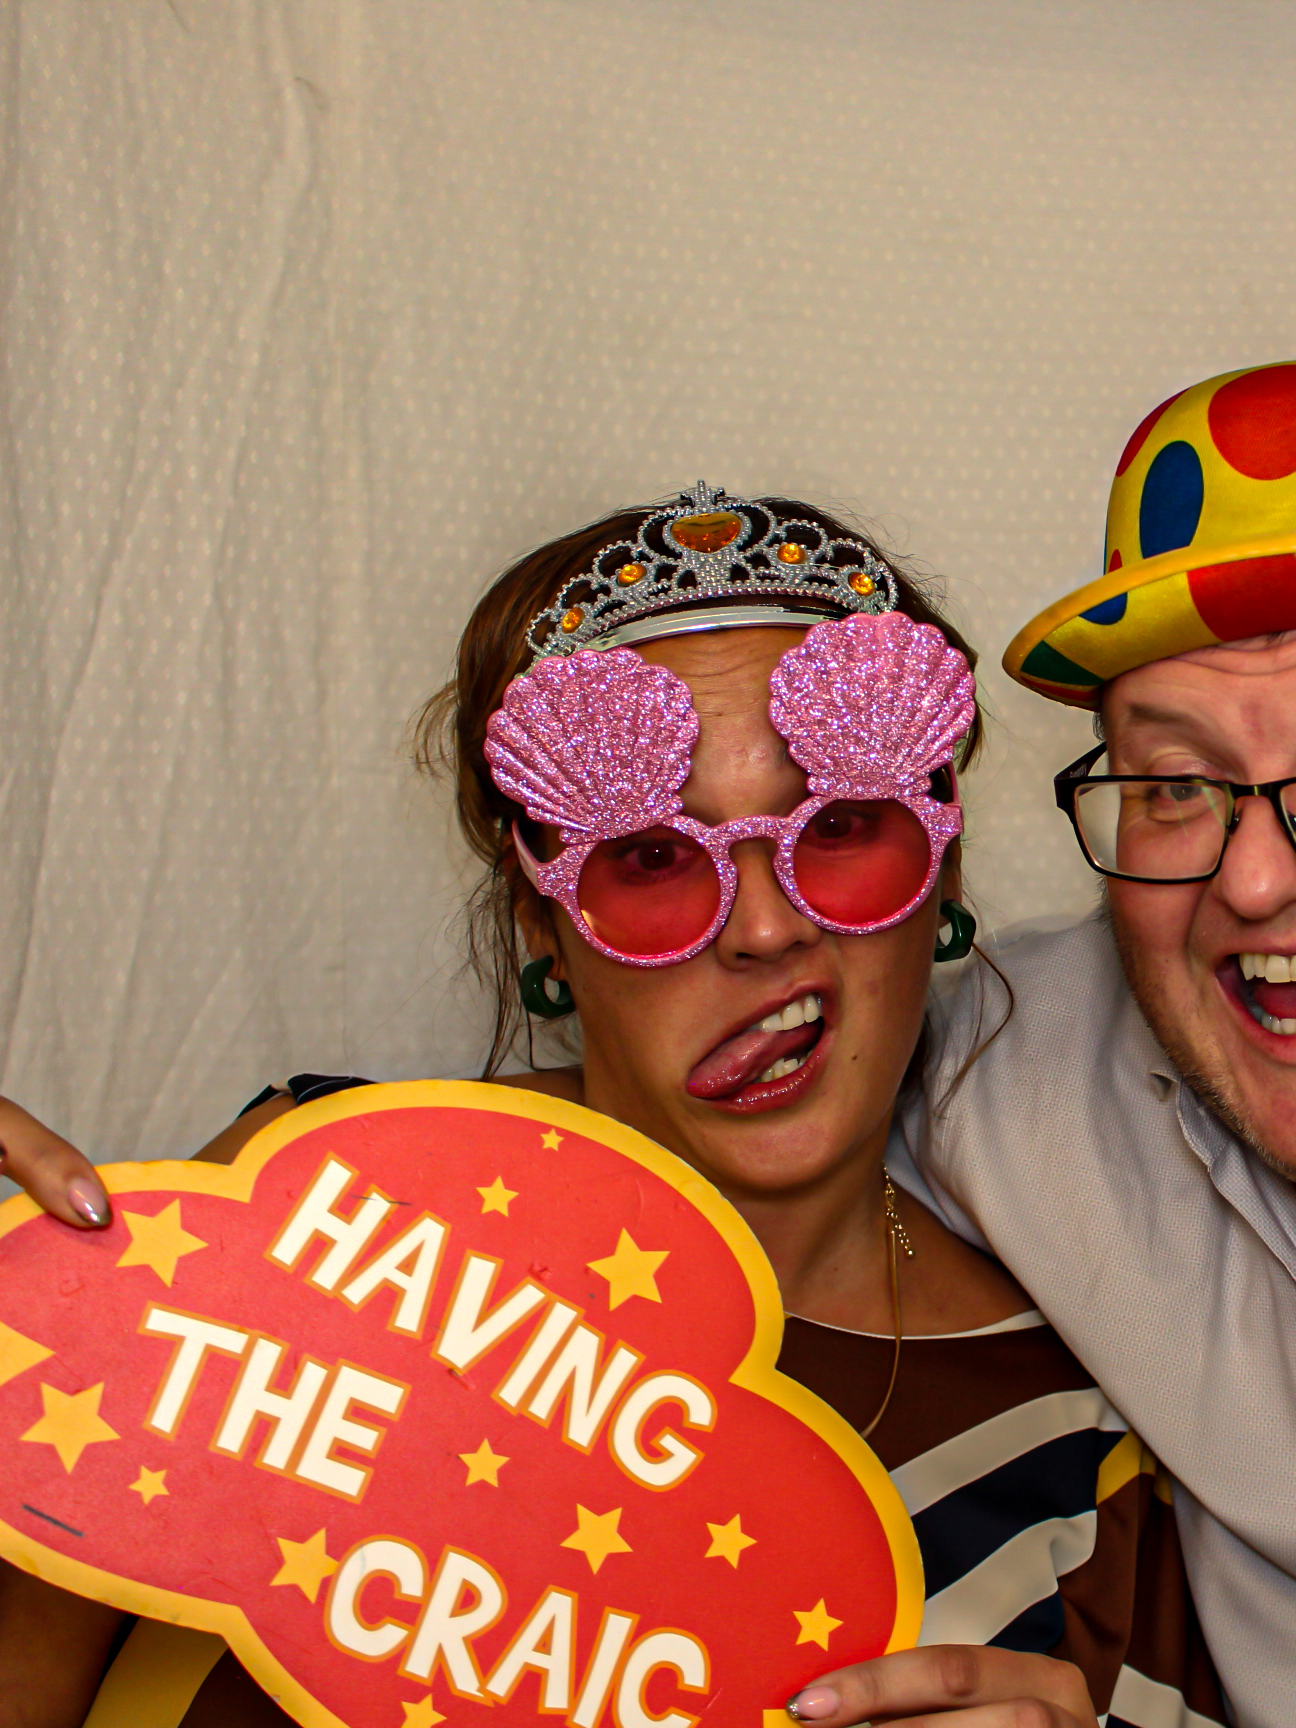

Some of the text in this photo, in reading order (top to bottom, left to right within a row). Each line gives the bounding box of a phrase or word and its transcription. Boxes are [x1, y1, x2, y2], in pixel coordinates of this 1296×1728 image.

[144, 1306, 405, 1498] THE
[270, 1158, 714, 1489] HAVING
[328, 1538, 707, 1728] CRAIC
